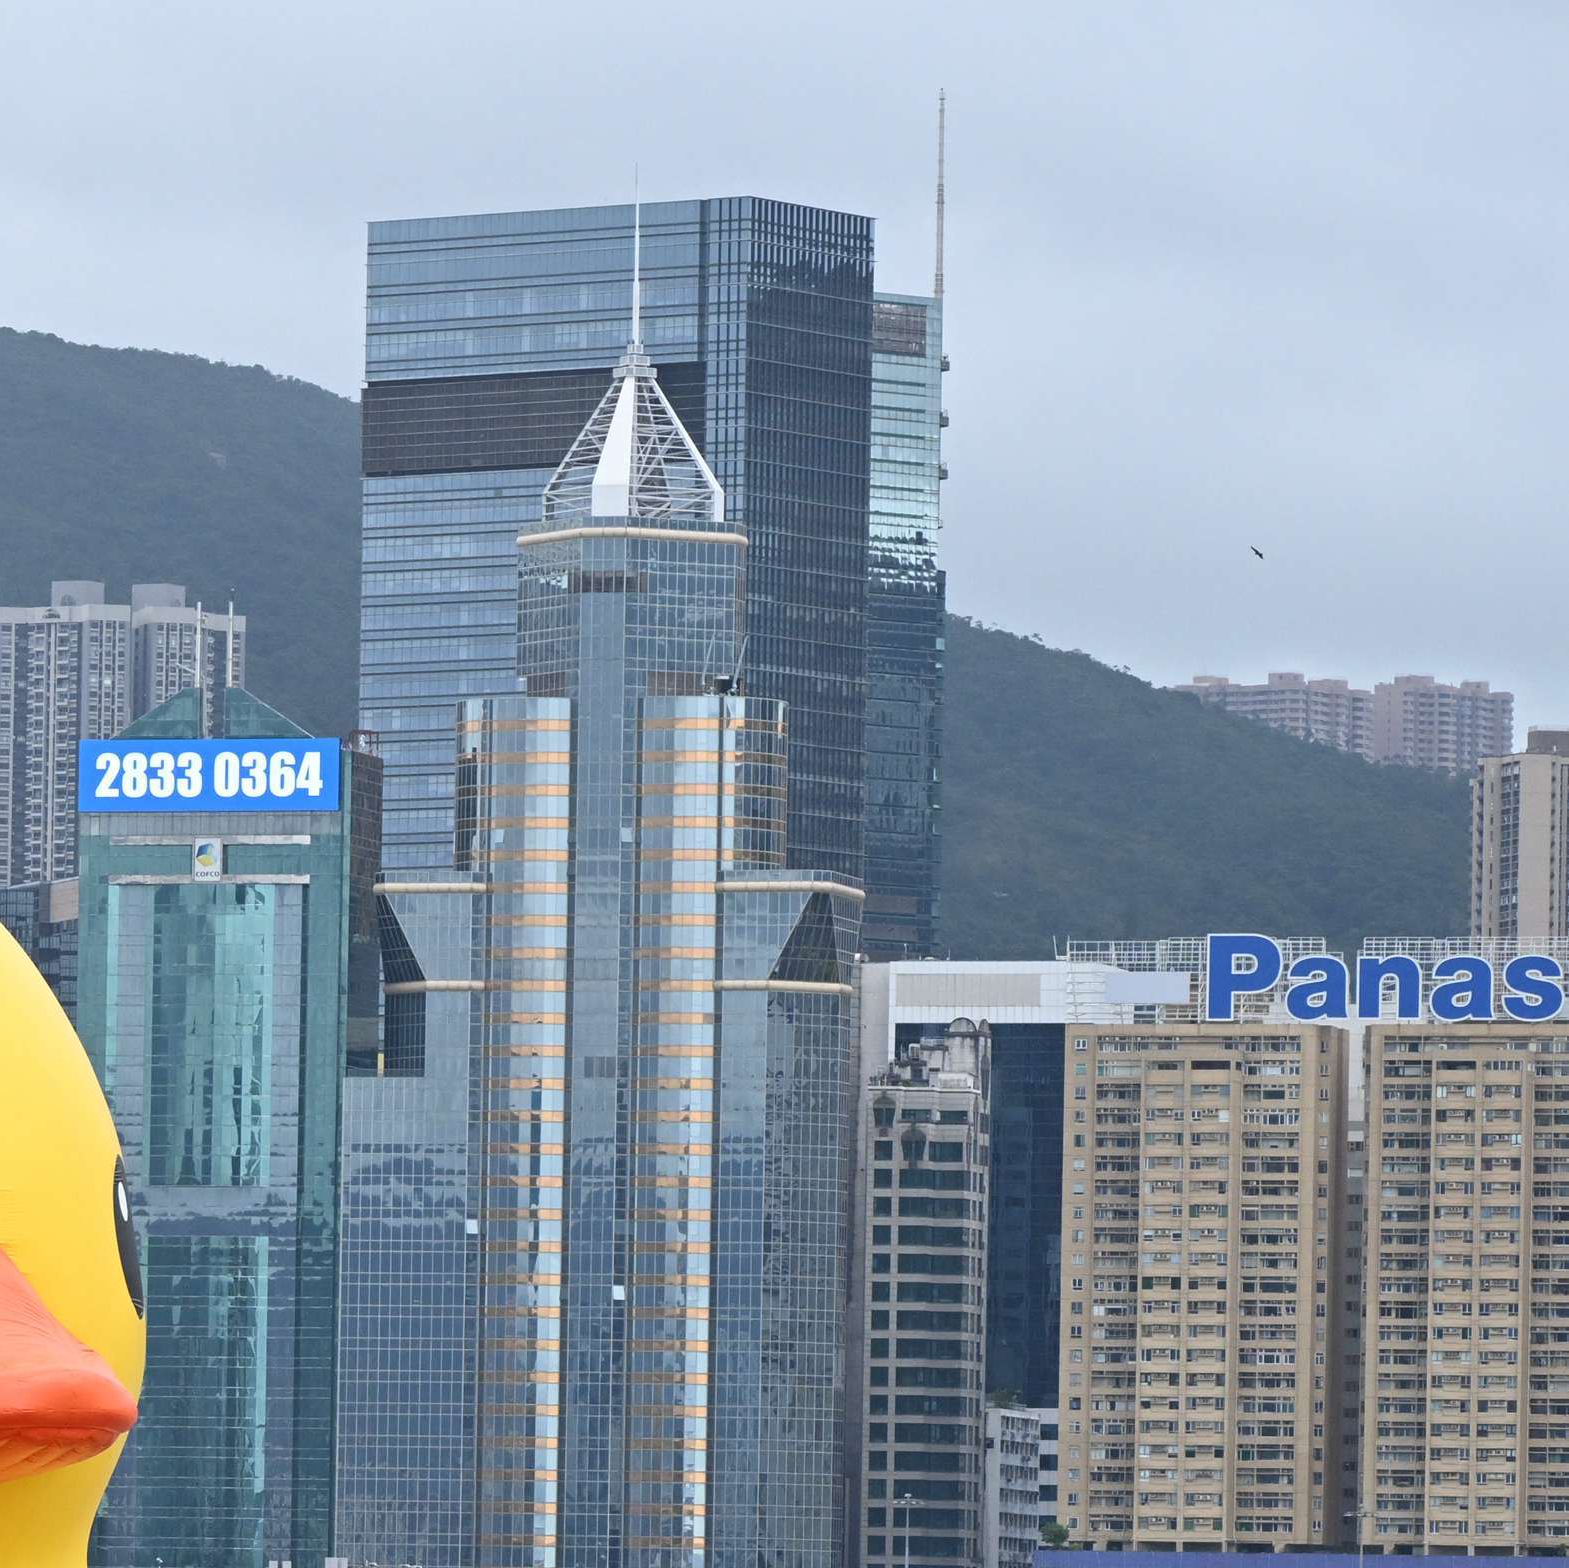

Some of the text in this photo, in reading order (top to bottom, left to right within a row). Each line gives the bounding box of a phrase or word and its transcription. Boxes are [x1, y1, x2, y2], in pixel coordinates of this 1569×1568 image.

[95, 751, 323, 798] 2833 0364
[1206, 933, 1564, 1022] Panas
